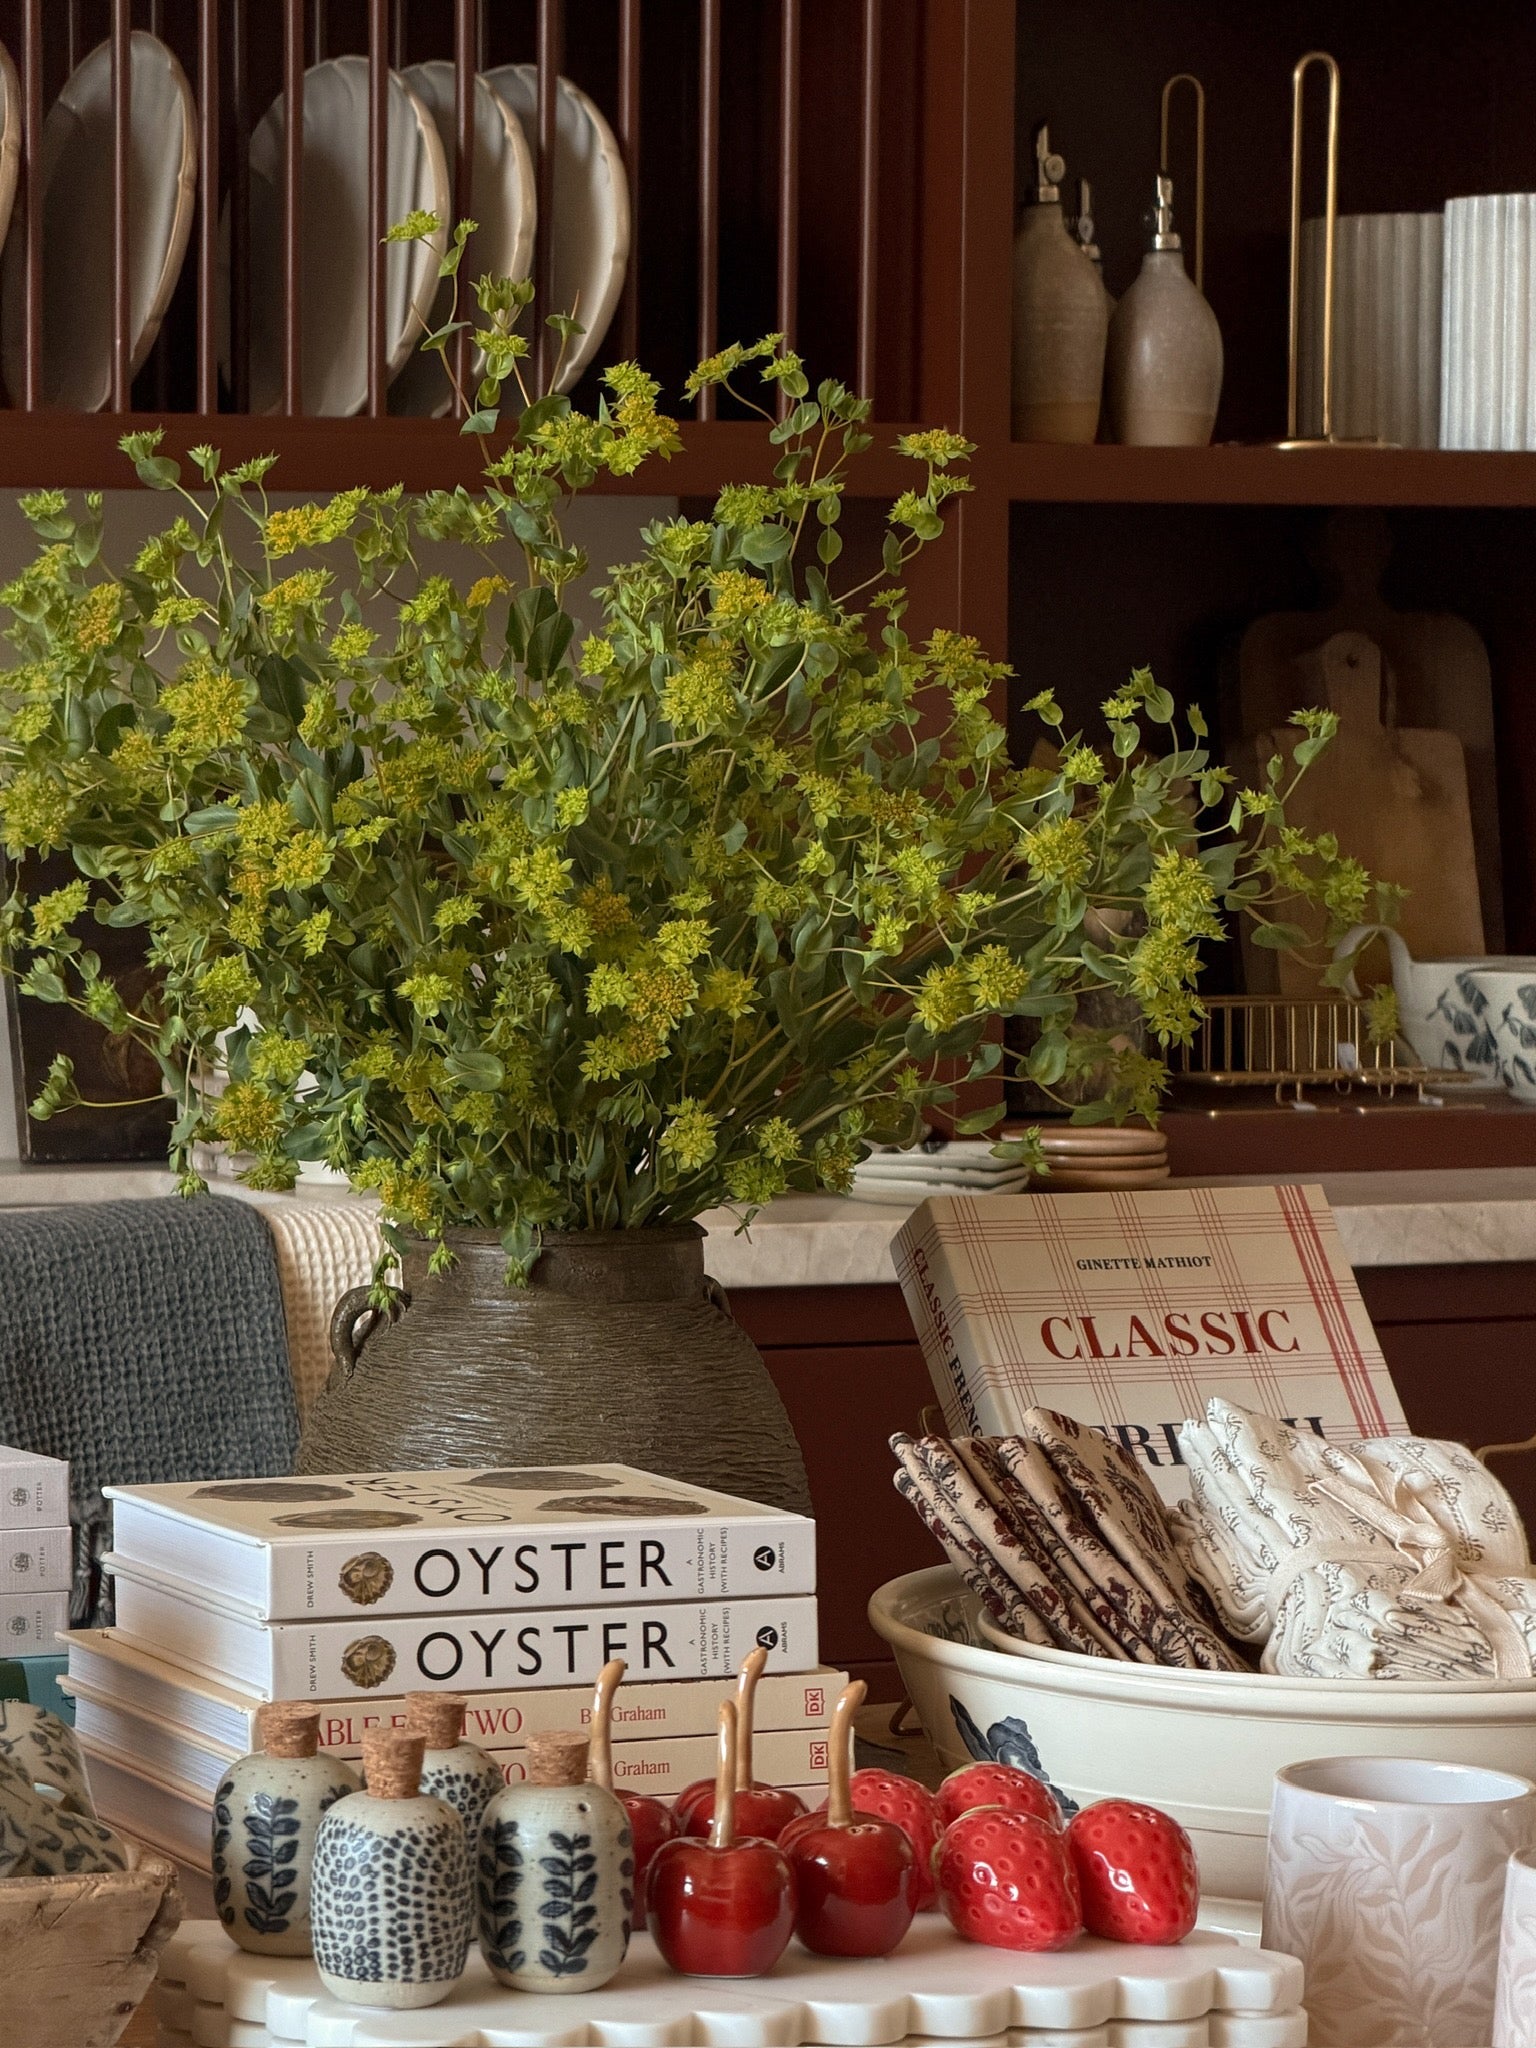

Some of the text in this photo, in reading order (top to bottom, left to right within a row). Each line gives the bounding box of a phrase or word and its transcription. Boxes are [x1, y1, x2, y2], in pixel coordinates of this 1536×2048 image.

[1076, 1255, 1212, 1271] GINETTE MATHIOT
[913, 1248, 984, 1437] CLASSIC FRENC
[1040, 1309, 1301, 1360] CLASSIC
[345, 1477, 512, 1522] OYSTER
[306, 1550, 314, 1608] DREW SMITH
[413, 1540, 674, 1598] OYSTER
[697, 1528, 705, 1594] GASTRONOMIC
[720, 1527, 729, 1593] (WITH RECIPES)
[309, 1634, 317, 1692] DREW SMITH
[416, 1621, 676, 1681] OYSTER
[699, 1608, 707, 1675] GASTRONOMIC
[711, 1622, 719, 1660] HISTORY
[722, 1607, 731, 1673] (WITH RECIPES)
[461, 1706, 523, 1737] TWO
[611, 1705, 667, 1722] Graham
[808, 1691, 820, 1713] DK
[614, 1759, 671, 1777] Graham
[814, 1744, 825, 1766] DK
